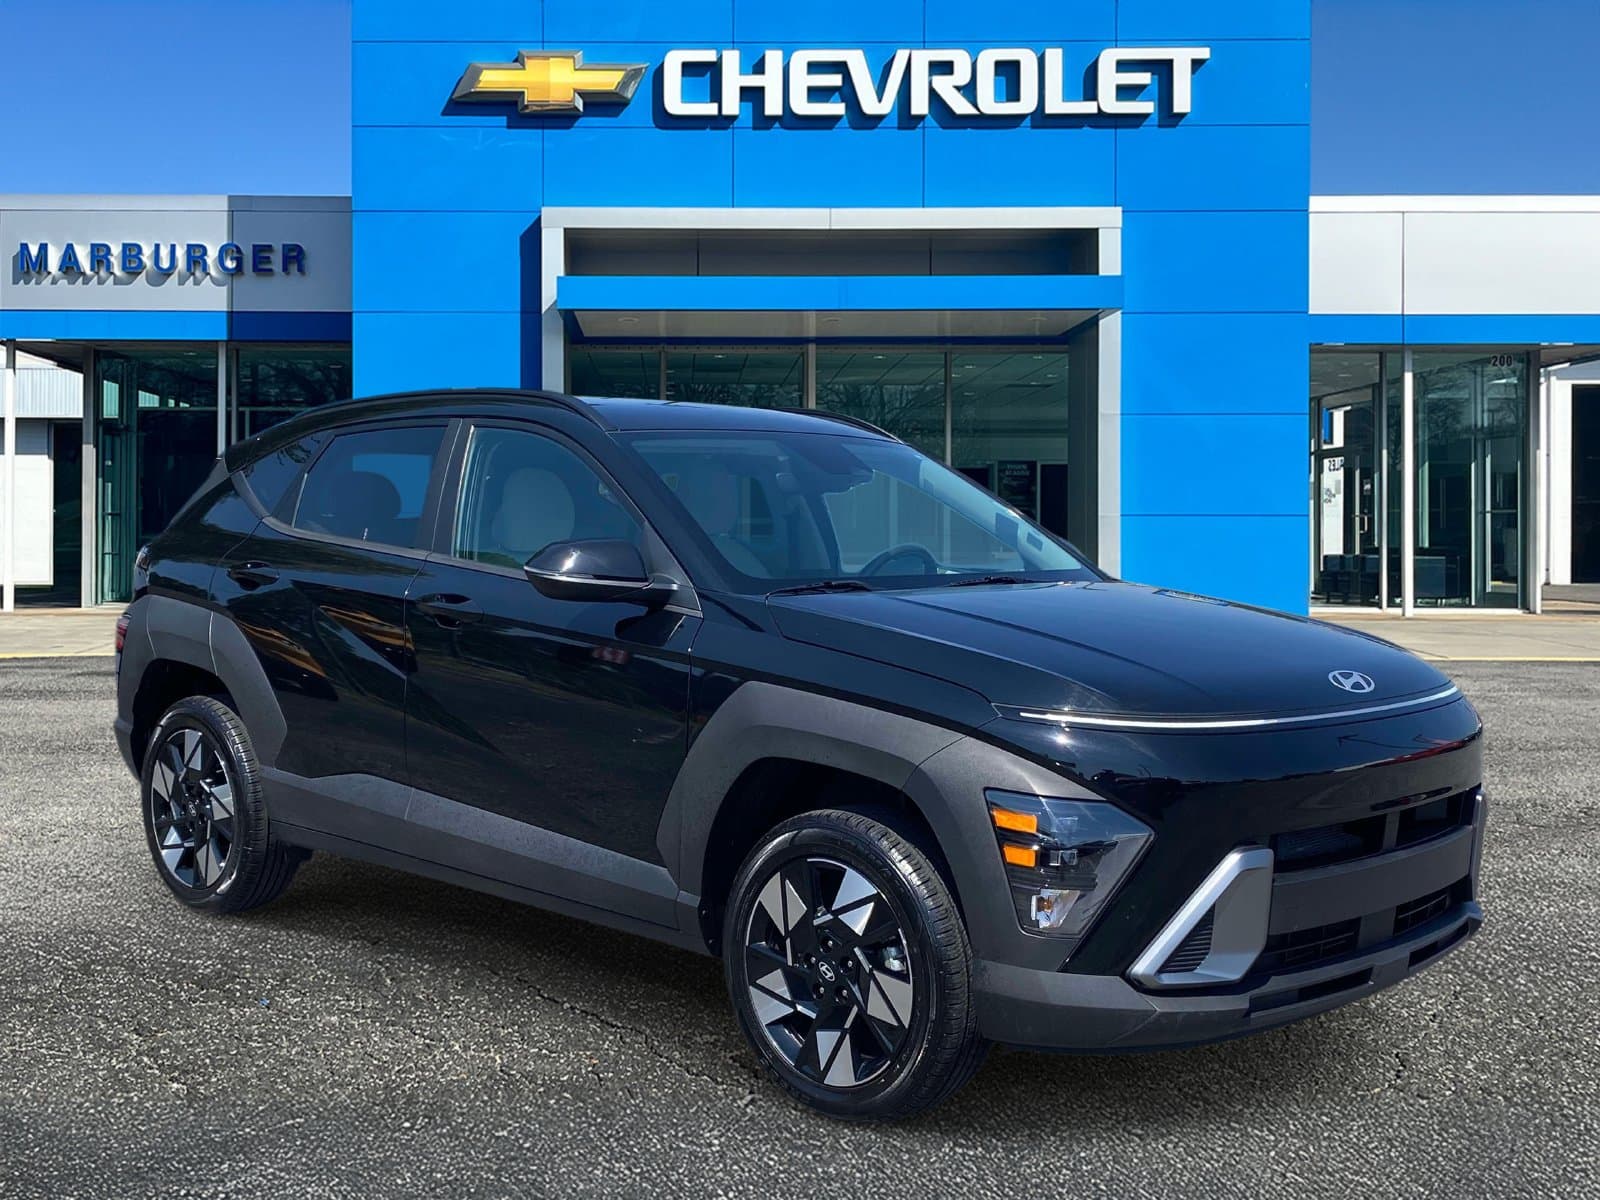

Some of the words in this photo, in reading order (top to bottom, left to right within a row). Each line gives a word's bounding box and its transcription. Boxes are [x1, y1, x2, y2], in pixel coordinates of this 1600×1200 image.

[663, 47, 1210, 116] CHEVROLET
[18, 242, 306, 274] MARBURGER
[1491, 355, 1513, 367] 200
